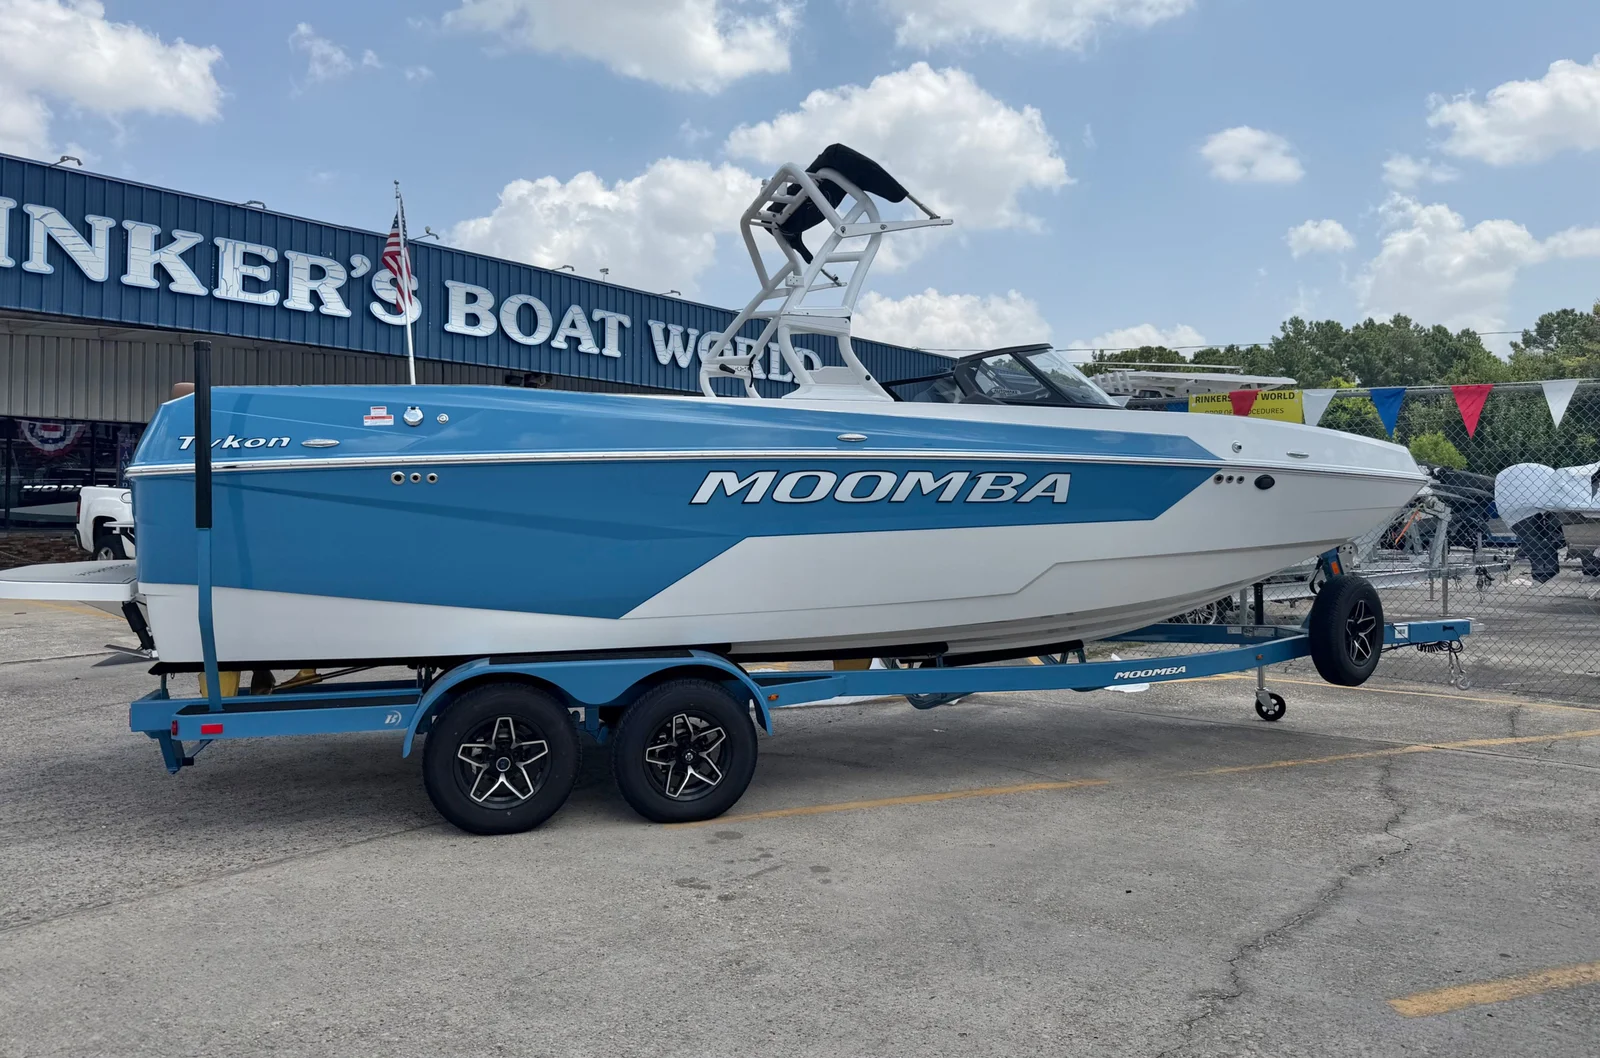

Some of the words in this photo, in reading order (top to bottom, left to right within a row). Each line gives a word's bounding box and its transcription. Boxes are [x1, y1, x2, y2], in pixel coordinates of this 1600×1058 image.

[444, 279, 631, 358] BOAT
[1261, 392, 1295, 401] WORLD
[1248, 407, 1284, 415] OCEDURES
[688, 470, 1072, 504] MOOMBA
[1113, 665, 1187, 680] MOOMBA
